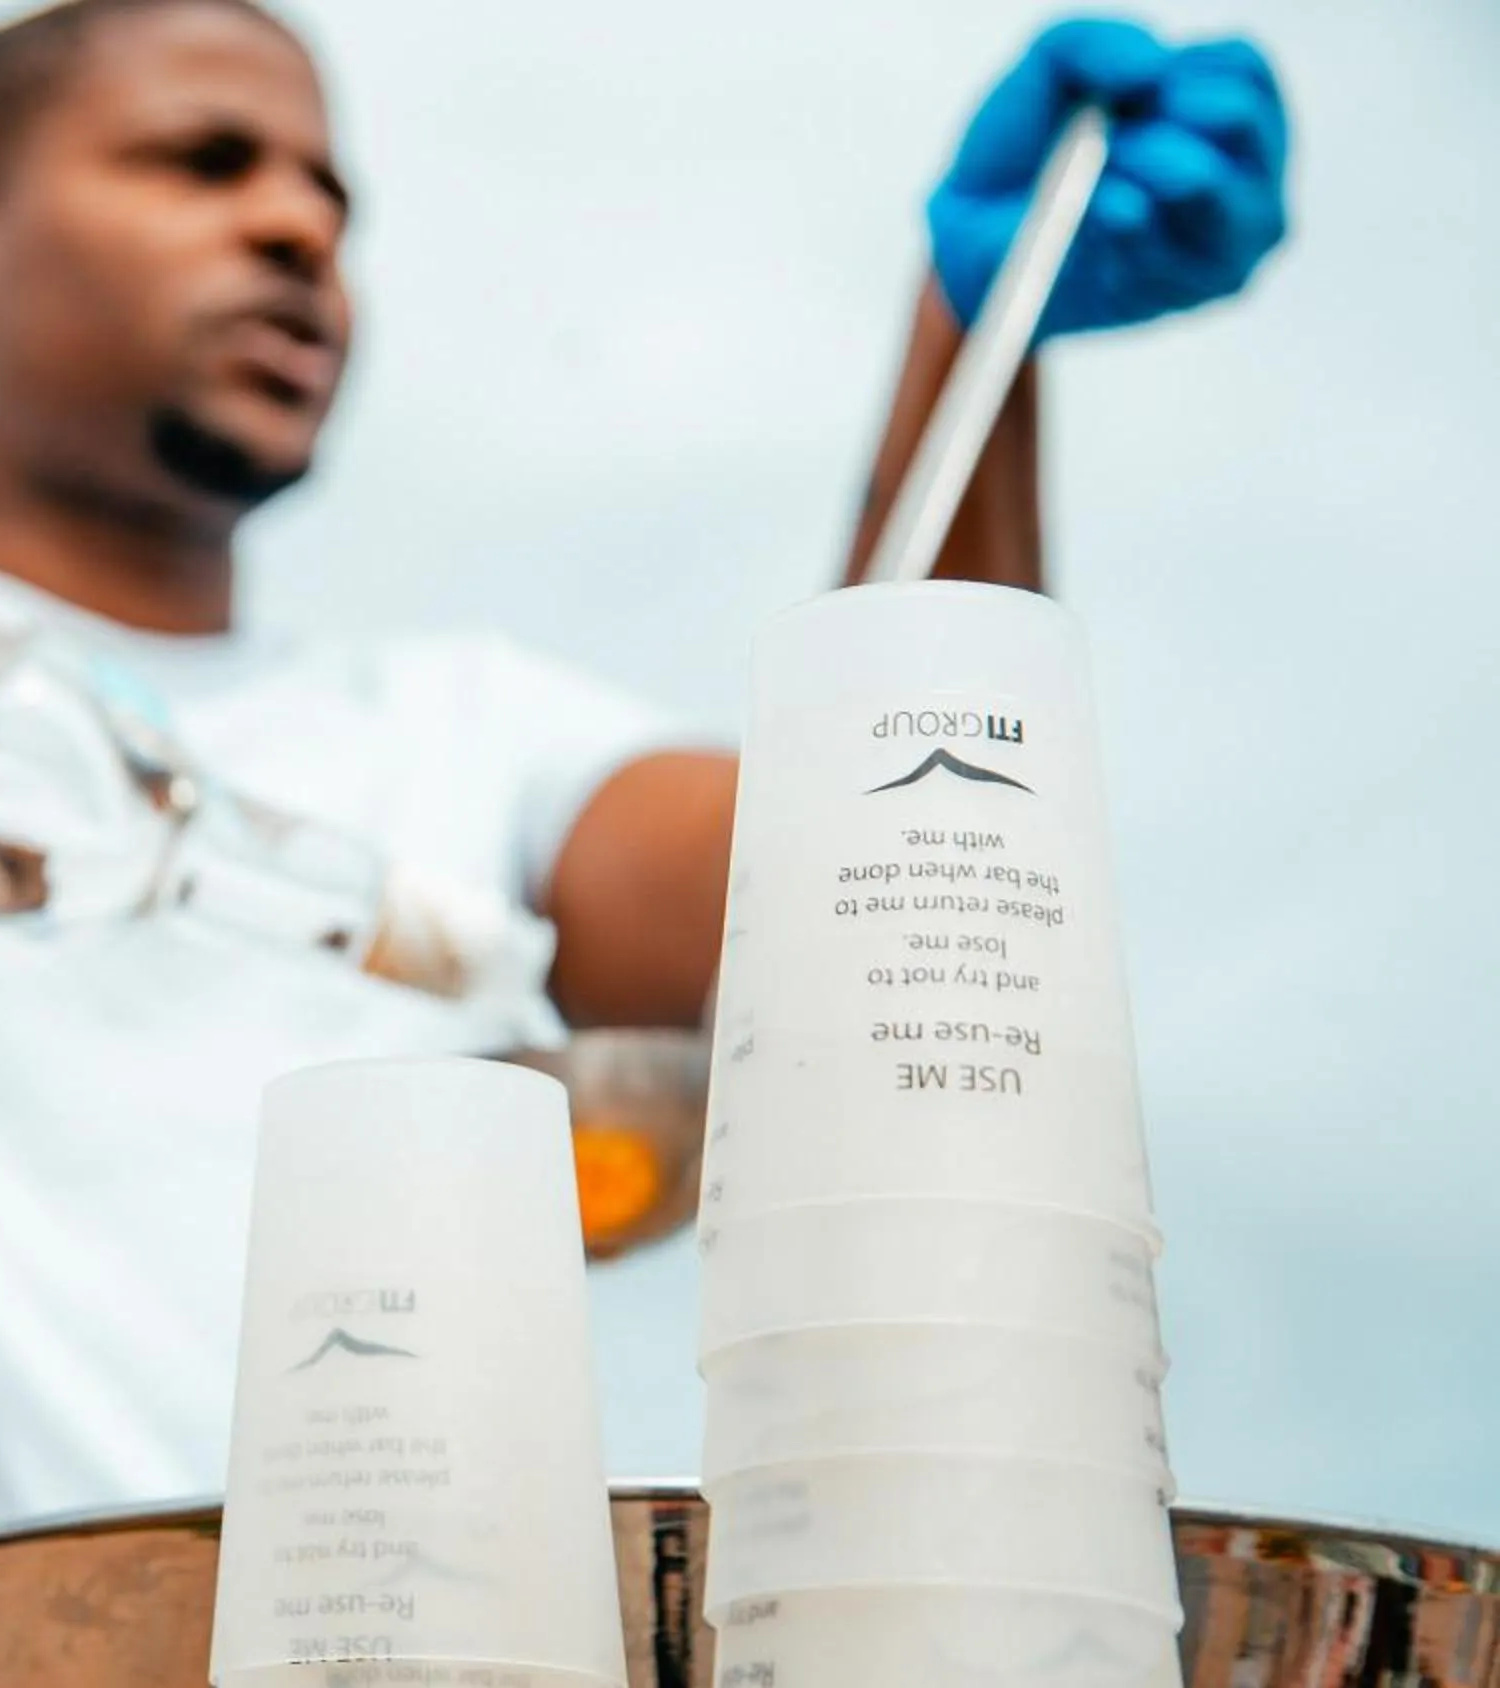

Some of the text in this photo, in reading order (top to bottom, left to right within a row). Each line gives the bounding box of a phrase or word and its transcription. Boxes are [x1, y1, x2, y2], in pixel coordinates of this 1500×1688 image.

[901, 829, 1005, 852] with me.
[838, 862, 1059, 895] the bar when done
[835, 895, 1064, 926] please return me to
[903, 932, 1007, 959] lose me.
[868, 965, 1040, 992] and try not to
[871, 1022, 1041, 1056] Re-use me
[897, 1063, 1022, 1096] USE ME
[274, 1594, 414, 1621] Re-use me
